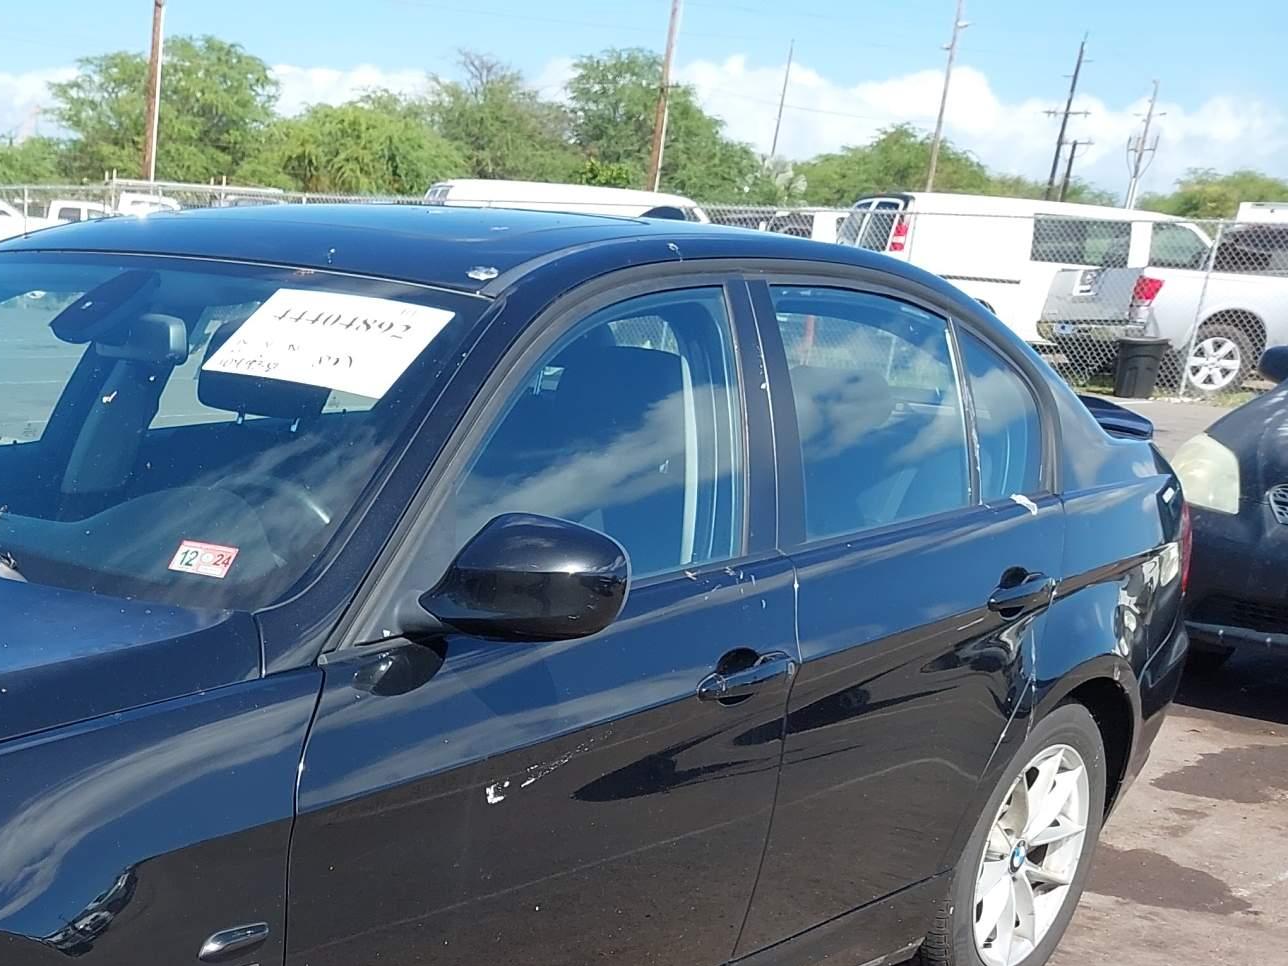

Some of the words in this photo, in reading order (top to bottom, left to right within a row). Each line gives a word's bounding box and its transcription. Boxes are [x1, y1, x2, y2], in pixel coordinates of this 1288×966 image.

[273, 308, 412, 340] 44404892
[179, 548, 199, 567] 12
[213, 553, 232, 568] 24
